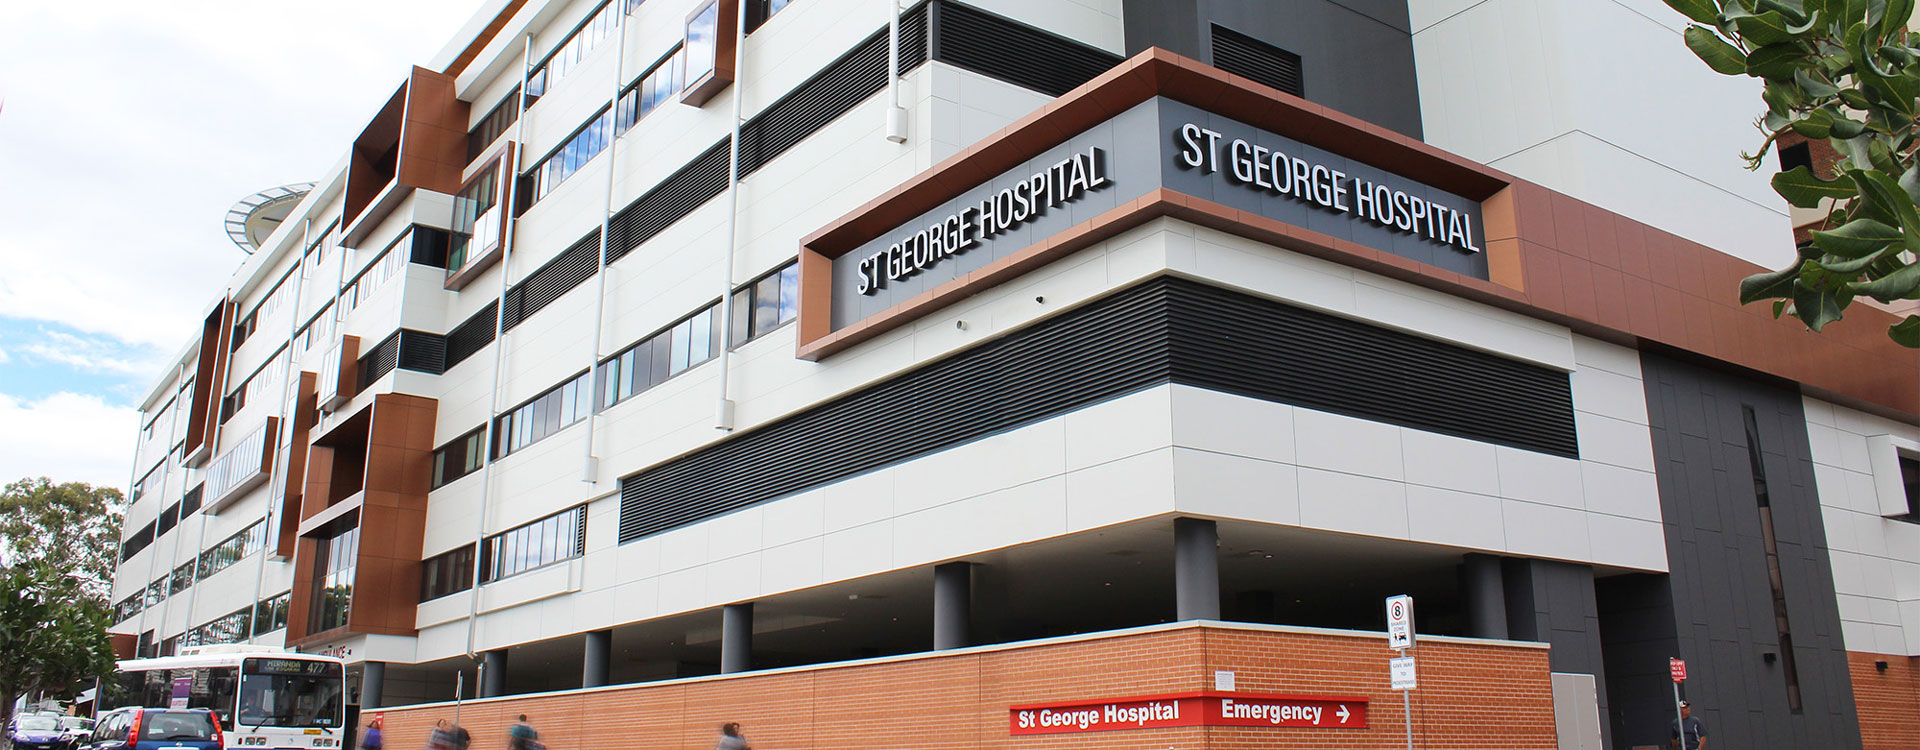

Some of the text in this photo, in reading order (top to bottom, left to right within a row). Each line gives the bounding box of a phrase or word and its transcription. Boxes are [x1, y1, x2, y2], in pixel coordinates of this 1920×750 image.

[1181, 123, 1480, 253] ST GEORGE HOSPITAL
[857, 146, 1105, 295] ST GEORGE HOSPITAL
[1394, 605, 1401, 617] 8
[307, 662, 326, 673] 477
[1018, 700, 1179, 729] St George Hospital
[1221, 699, 1322, 725] Emergency
